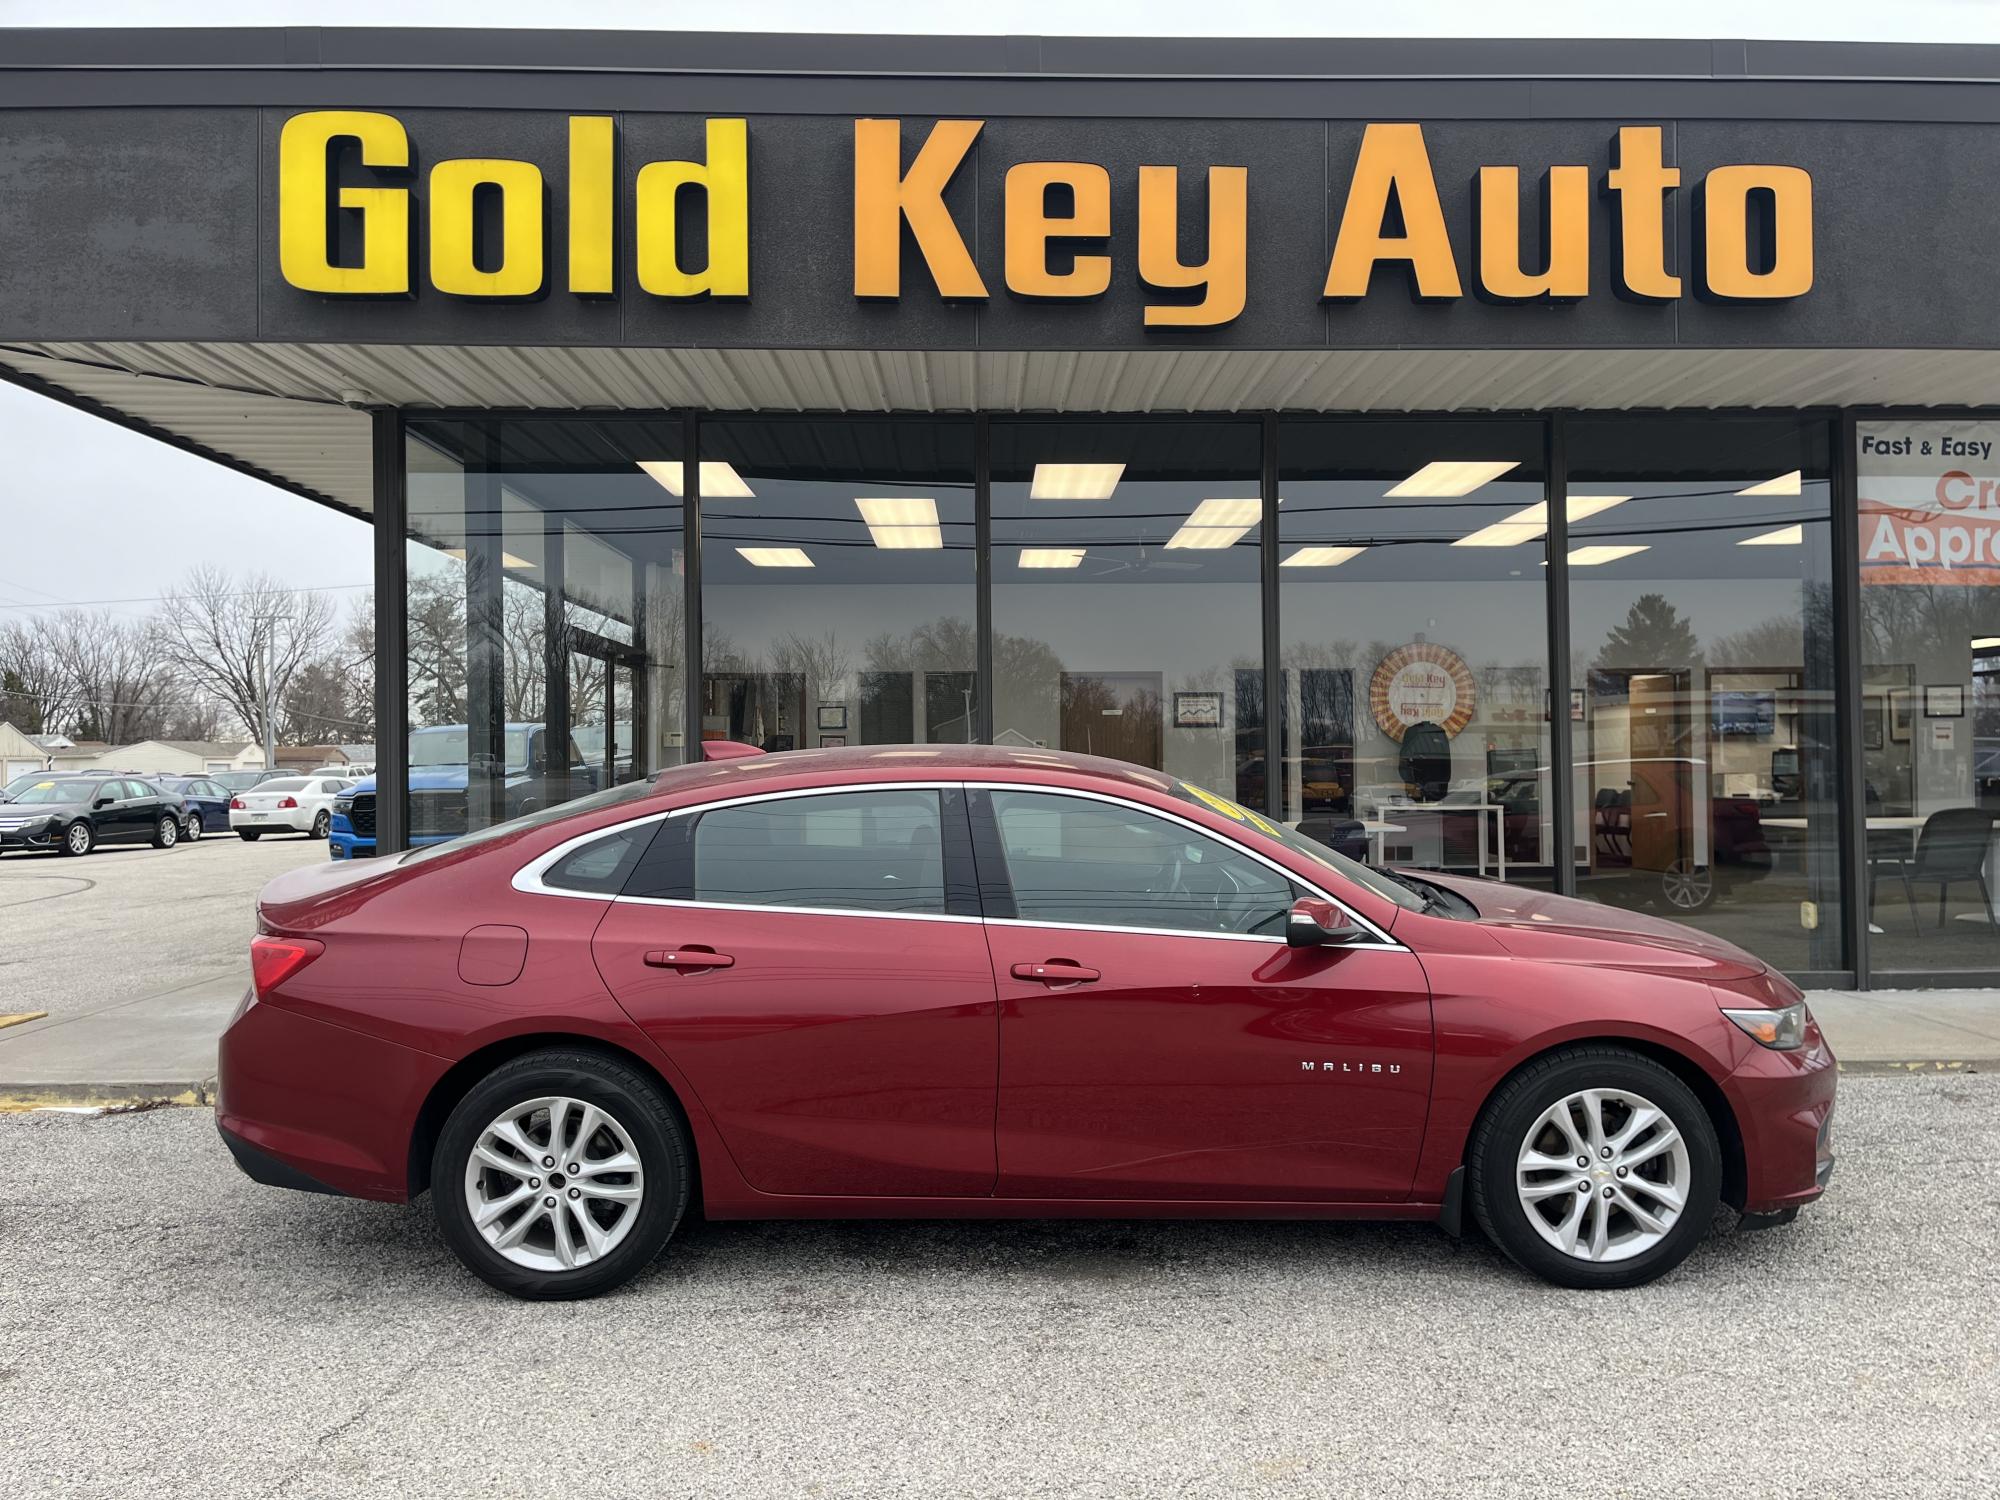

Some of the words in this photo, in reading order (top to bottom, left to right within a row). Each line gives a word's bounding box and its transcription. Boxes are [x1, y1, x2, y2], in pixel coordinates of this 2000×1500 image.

[279, 110, 749, 297] Gold
[854, 118, 1248, 326] Key
[1323, 123, 1814, 298] Auto
[1862, 435, 1912, 455] Fast
[1920, 440, 1932, 455] &
[1941, 437, 1992, 460] Easy
[1935, 470, 2000, 510] Cr
[1866, 514, 2000, 569] Appr
[1301, 1061, 1401, 1074] MALIBU
